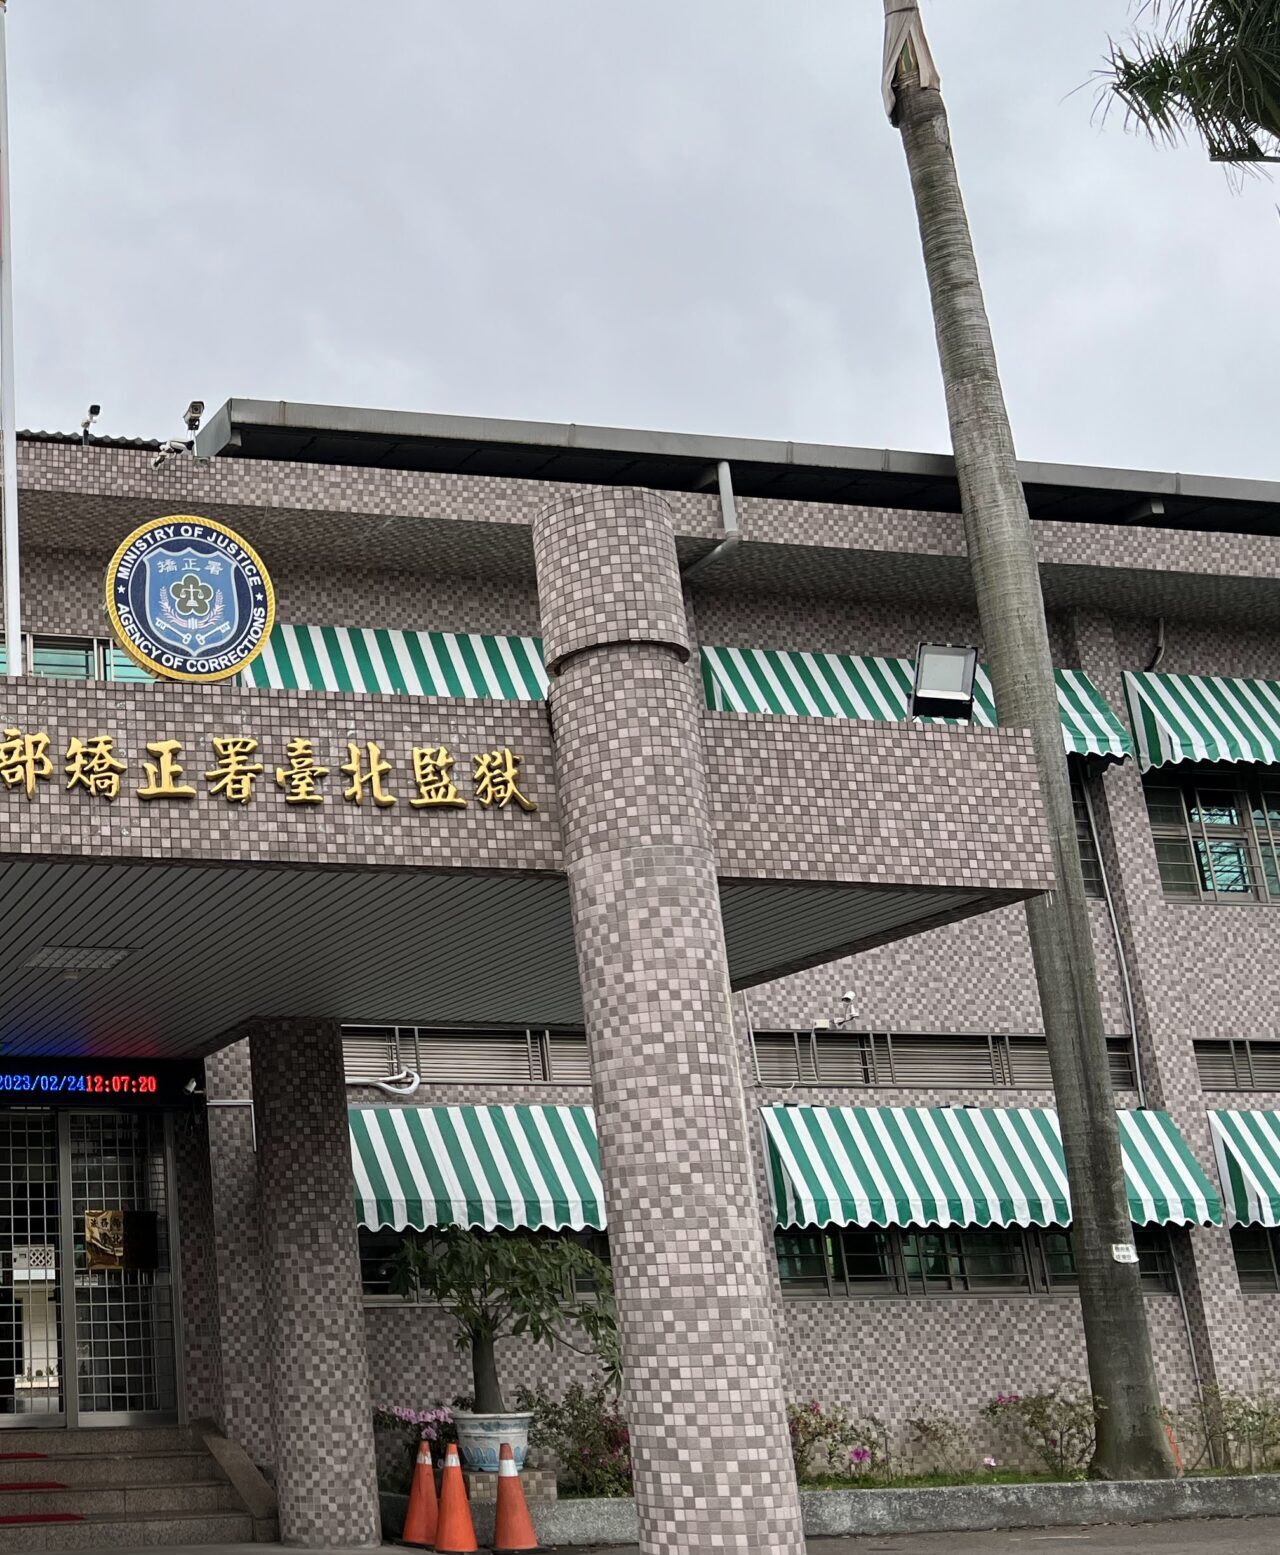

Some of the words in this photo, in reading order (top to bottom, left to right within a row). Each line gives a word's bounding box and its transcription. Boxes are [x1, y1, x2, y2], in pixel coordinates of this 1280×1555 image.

[118, 526, 175, 580] MINISTRY
[180, 525, 204, 538] OF
[207, 531, 262, 587] JUSTICE
[157, 558, 224, 575] 矯正署
[117, 603, 159, 659] AGENCY
[161, 653, 184, 672] OF
[186, 607, 265, 673] CORRECTIONS
[86, 1074, 157, 1092] 12:07:20
